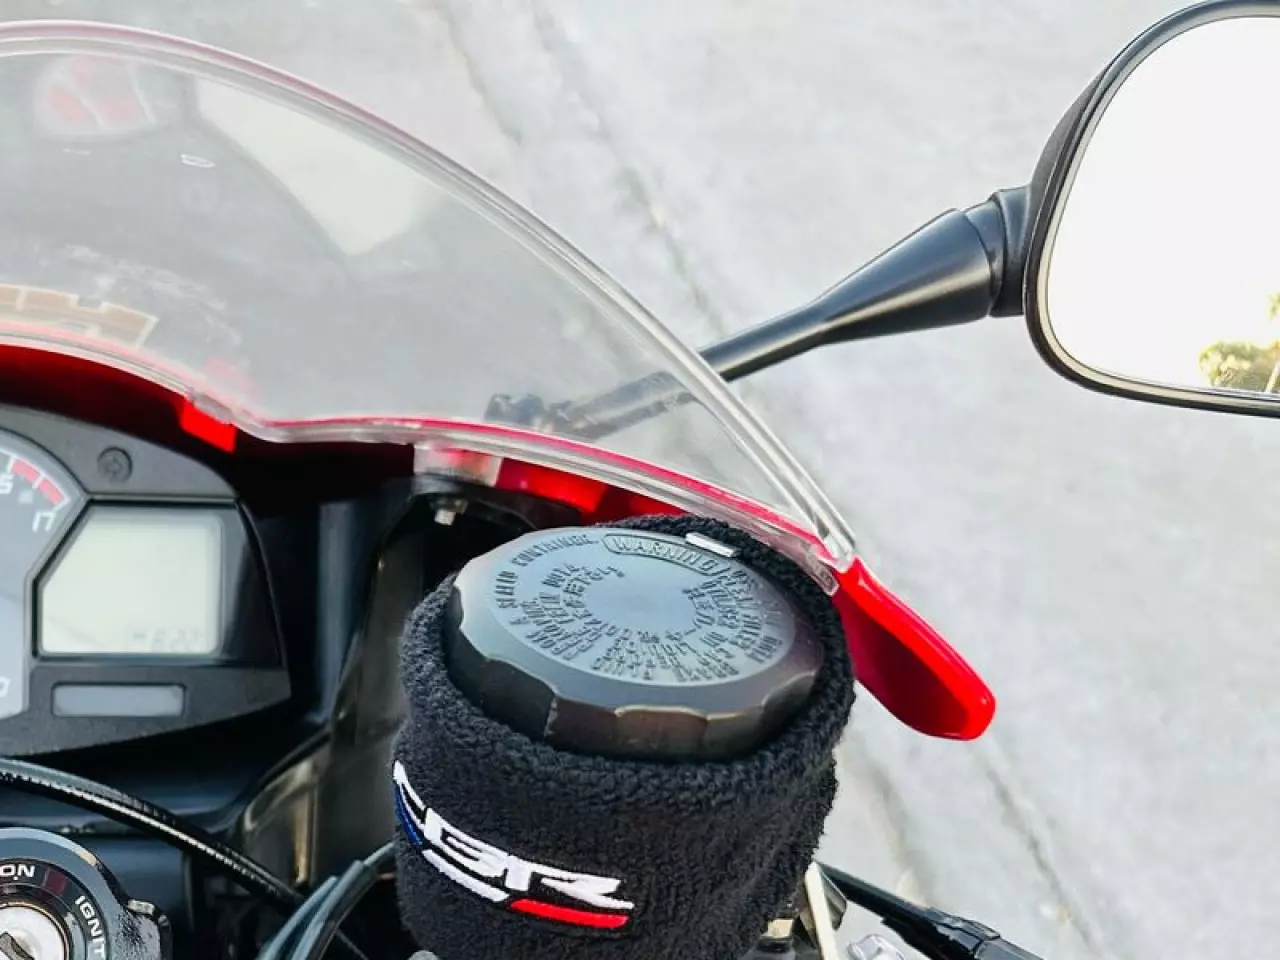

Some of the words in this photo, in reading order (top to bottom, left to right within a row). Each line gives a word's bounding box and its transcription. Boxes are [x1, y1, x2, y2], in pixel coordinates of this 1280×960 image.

[32, 511, 56, 533] 17
[612, 536, 719, 571] WARNING
[0, 863, 35, 878] ON
